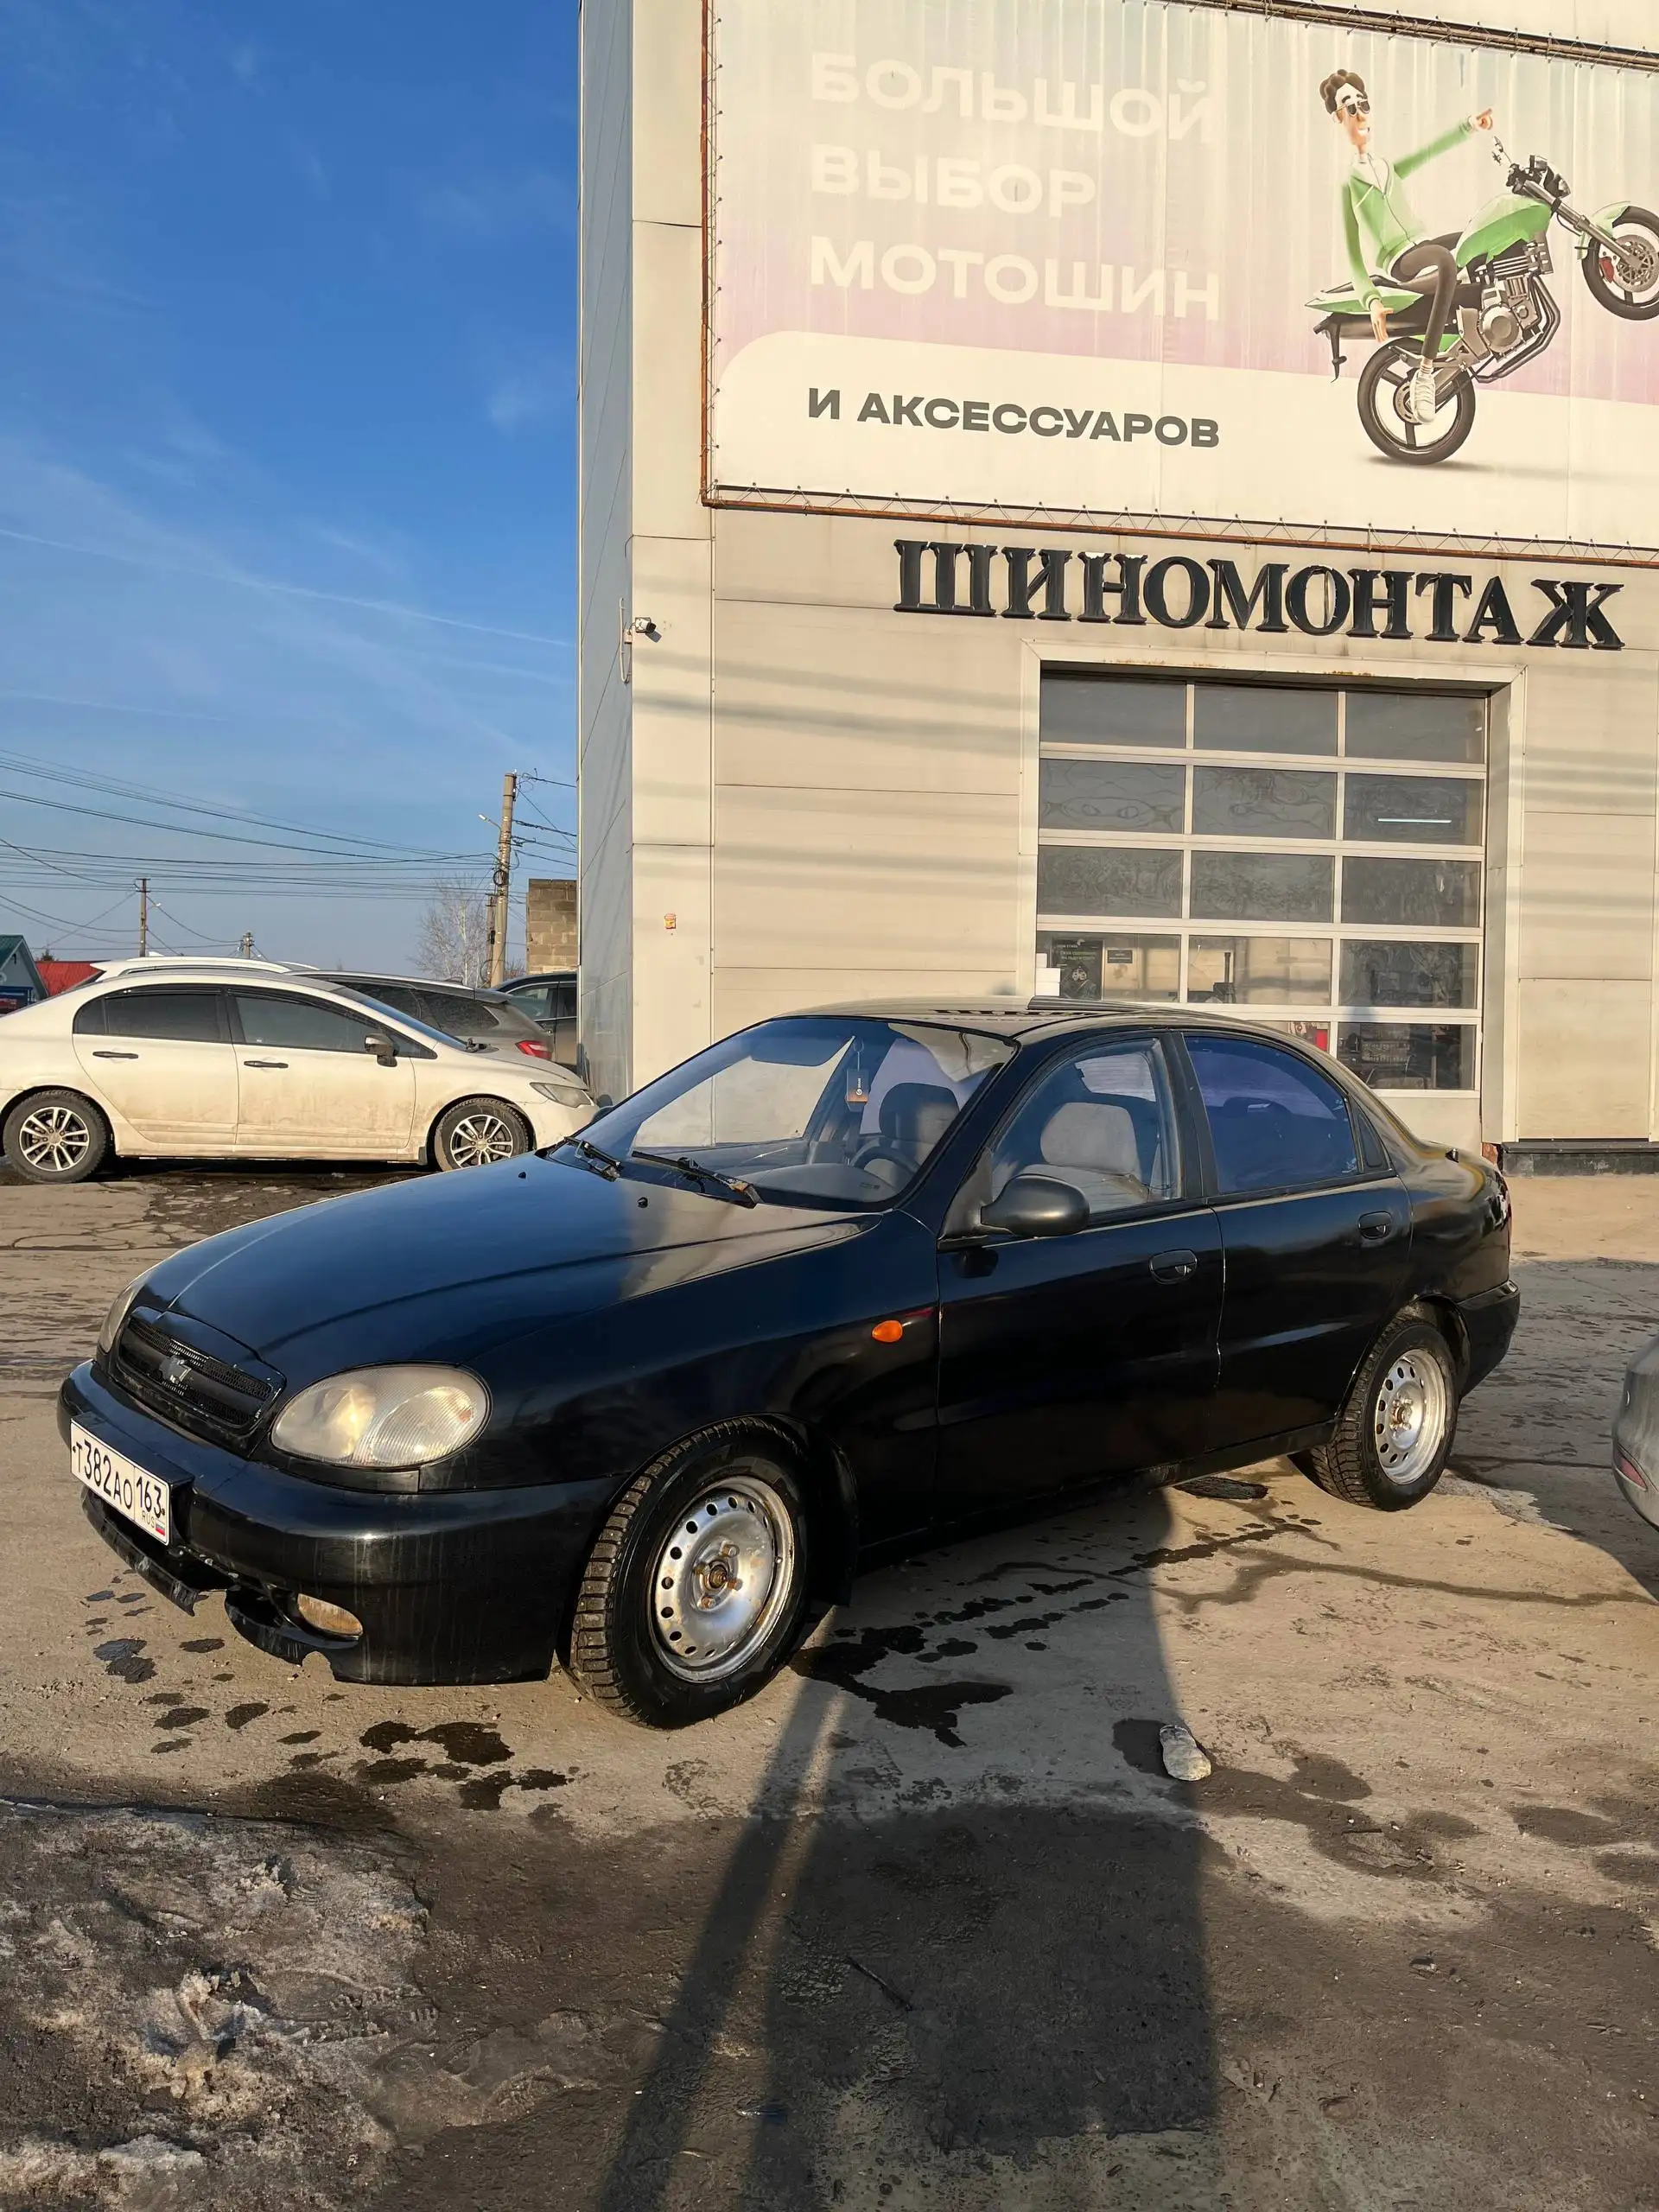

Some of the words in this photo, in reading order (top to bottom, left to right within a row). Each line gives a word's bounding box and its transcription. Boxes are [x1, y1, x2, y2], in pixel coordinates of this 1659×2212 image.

[810, 51, 1214, 143] БОЛЬШОЙ
[810, 145, 1096, 219] ВЫБОР
[810, 236, 1219, 321] МОТОШИН
[808, 387, 841, 420] И
[857, 392, 1219, 448] АКСЕССУАРОВ
[893, 539, 1624, 650] ШИНОМОНТАЖ
[136, 1476, 162, 1519] 163
[141, 1511, 156, 1529] RUS
